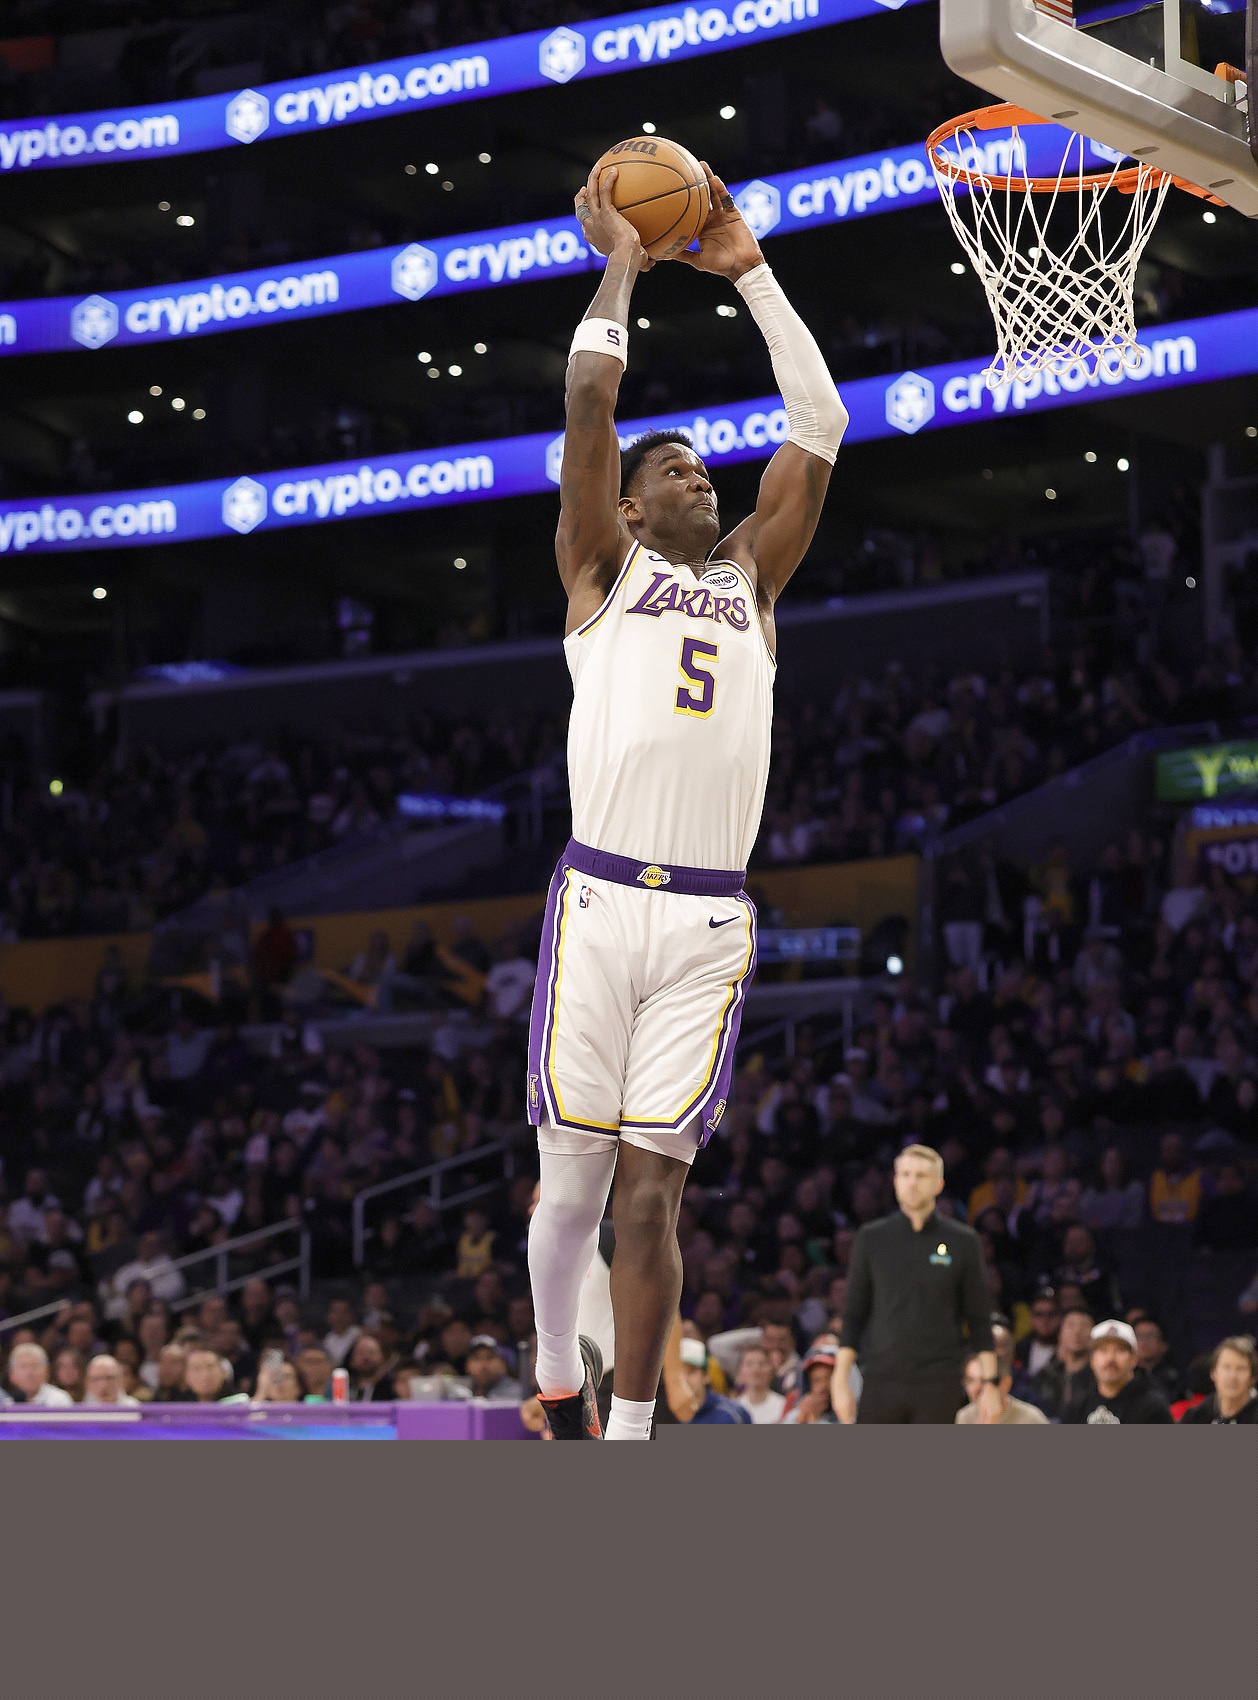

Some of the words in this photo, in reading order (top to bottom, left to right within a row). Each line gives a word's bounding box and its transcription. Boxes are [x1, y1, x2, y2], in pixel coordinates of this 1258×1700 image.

[592, 0, 820, 63] crypto.com
[274, 55, 489, 125] crypto.com
[610, 140, 658, 156] Wil
[125, 270, 340, 335] crypto.com
[942, 335, 1197, 413] crypto.com
[272, 455, 495, 519] crypto.com
[624, 571, 751, 633] LAKERS
[673, 634, 719, 720] 5
